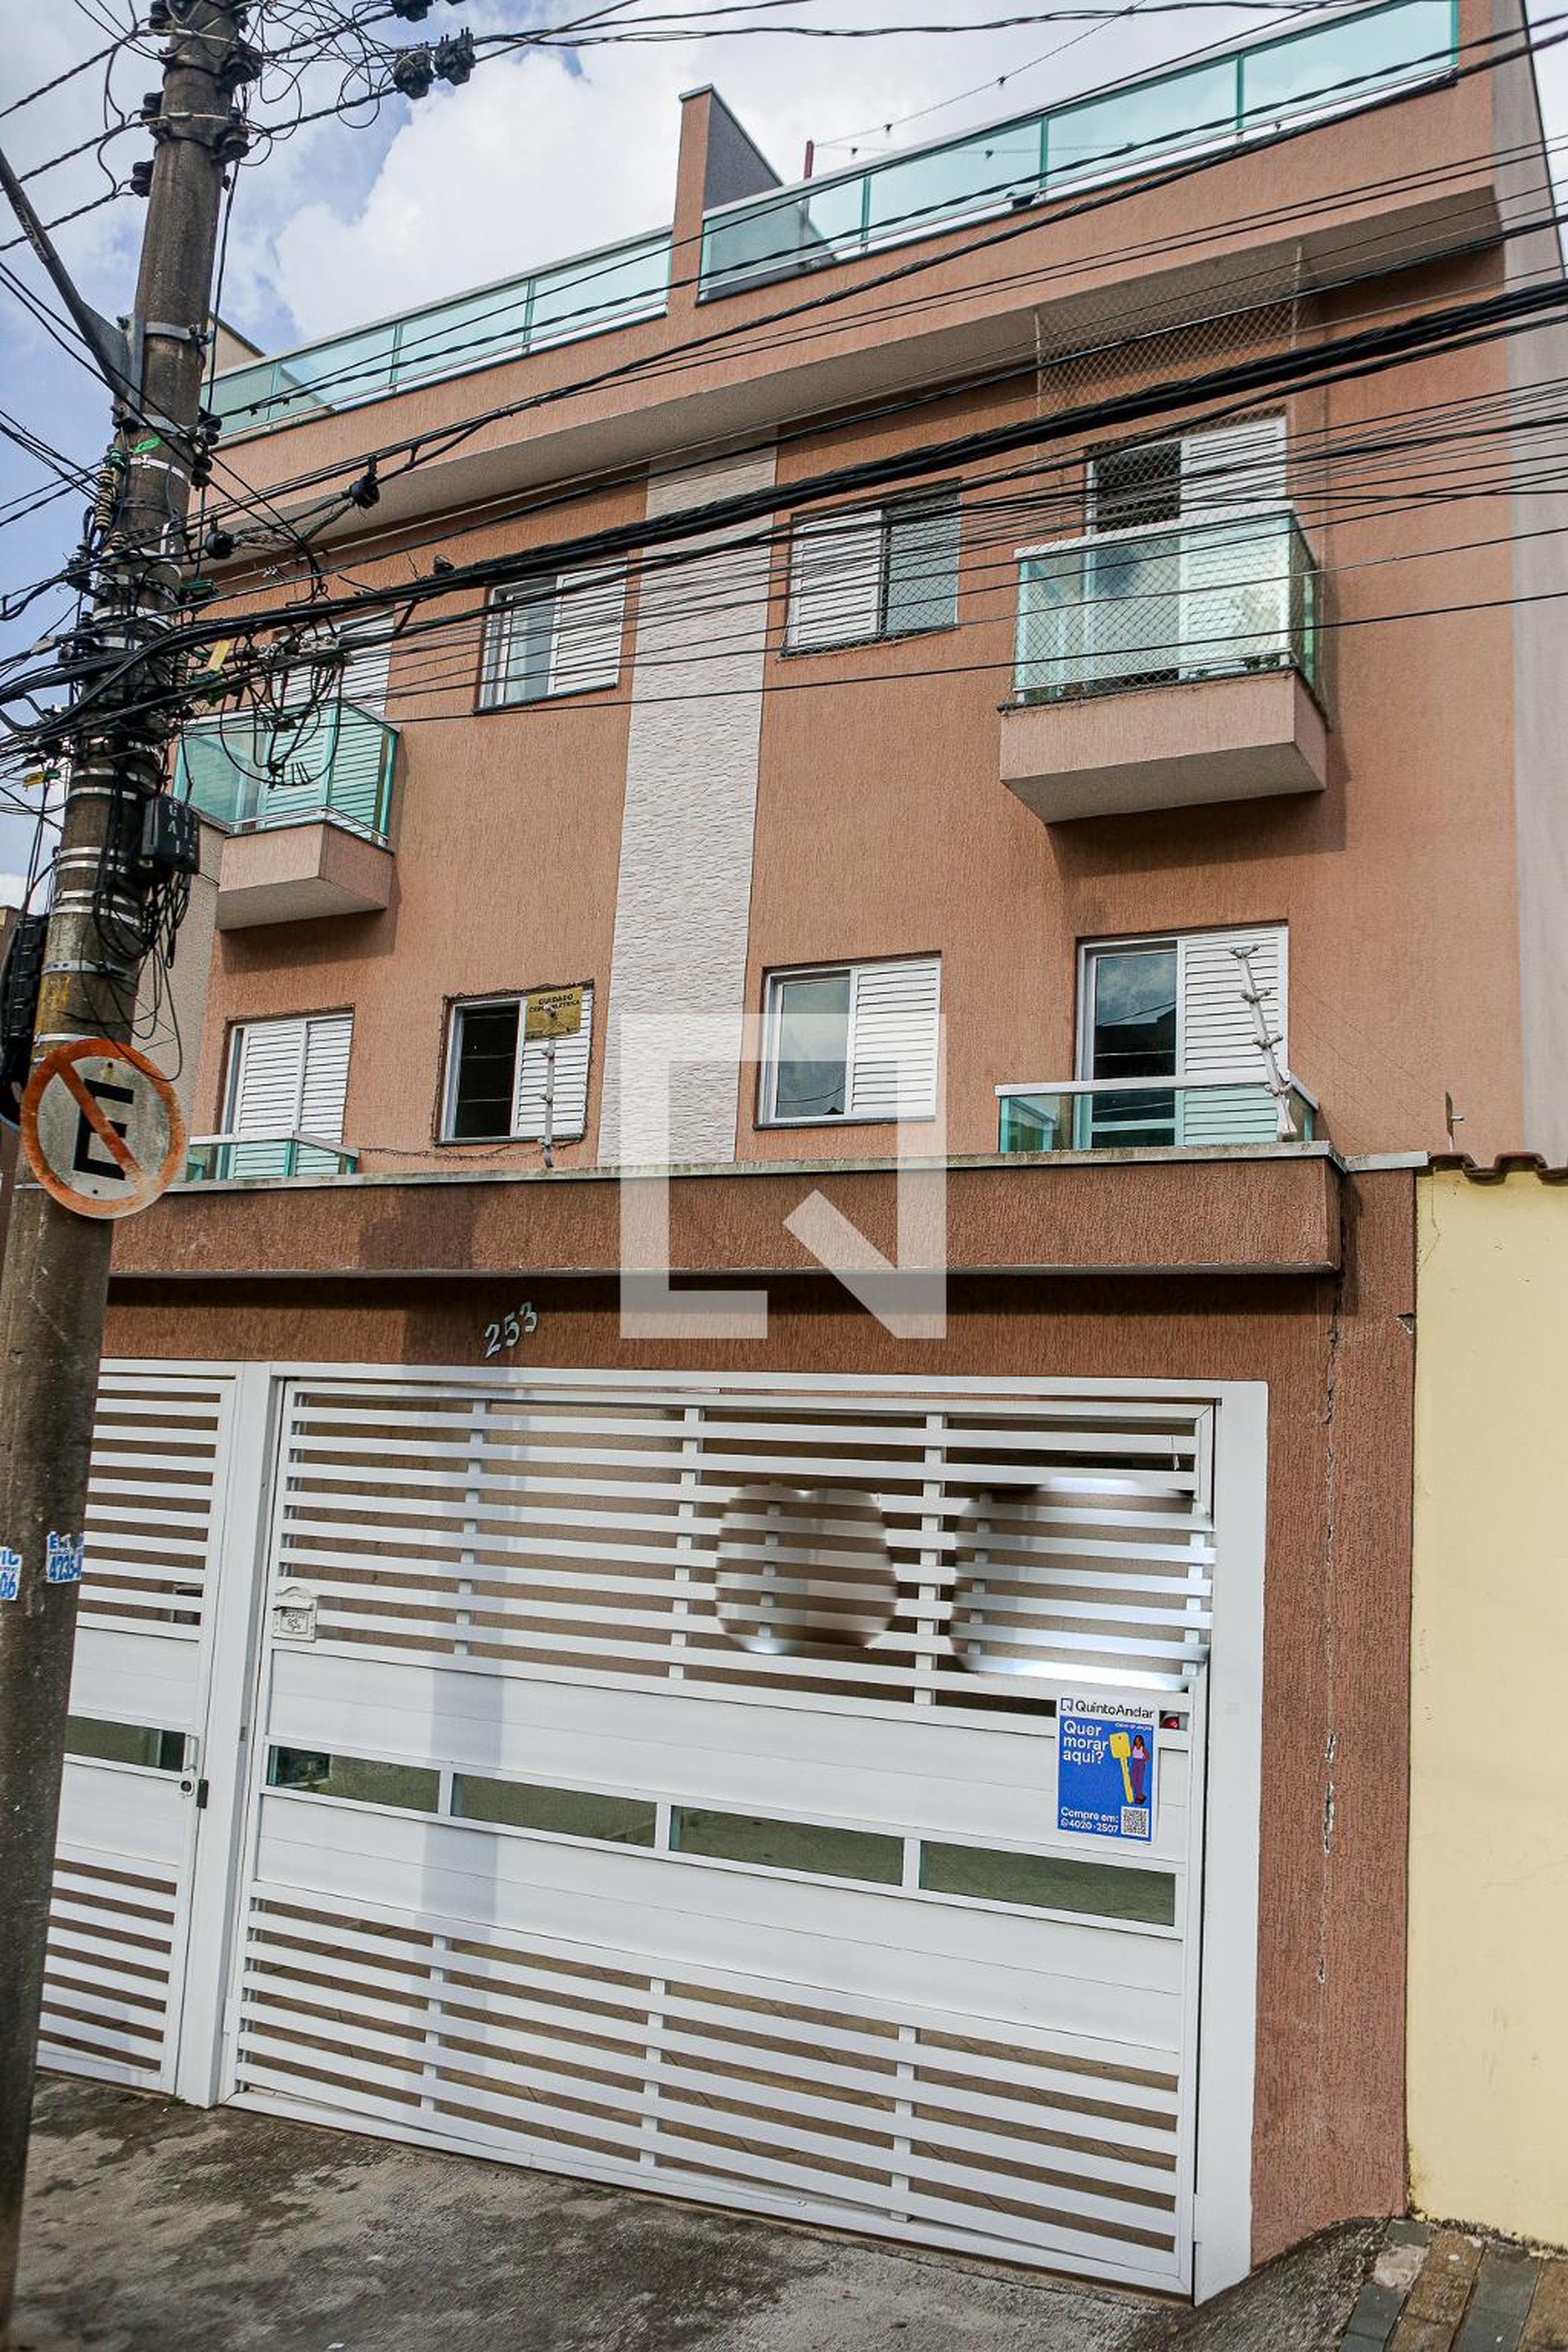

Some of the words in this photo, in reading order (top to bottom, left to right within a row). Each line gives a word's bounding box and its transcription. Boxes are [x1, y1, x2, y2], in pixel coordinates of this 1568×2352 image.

[538, 993, 573, 1005] CUIDADO
[73, 1078, 134, 1180] E
[485, 1301, 538, 1359] 253
[1075, 1700, 1154, 1719] QuintoAndar
[1064, 1720, 1102, 1736] Quer
[1063, 1736, 1109, 1751] morar
[1063, 1749, 1104, 1765] aqui?
[1061, 1806, 1099, 1820] Compre
[1101, 1814, 1119, 1823] em:
